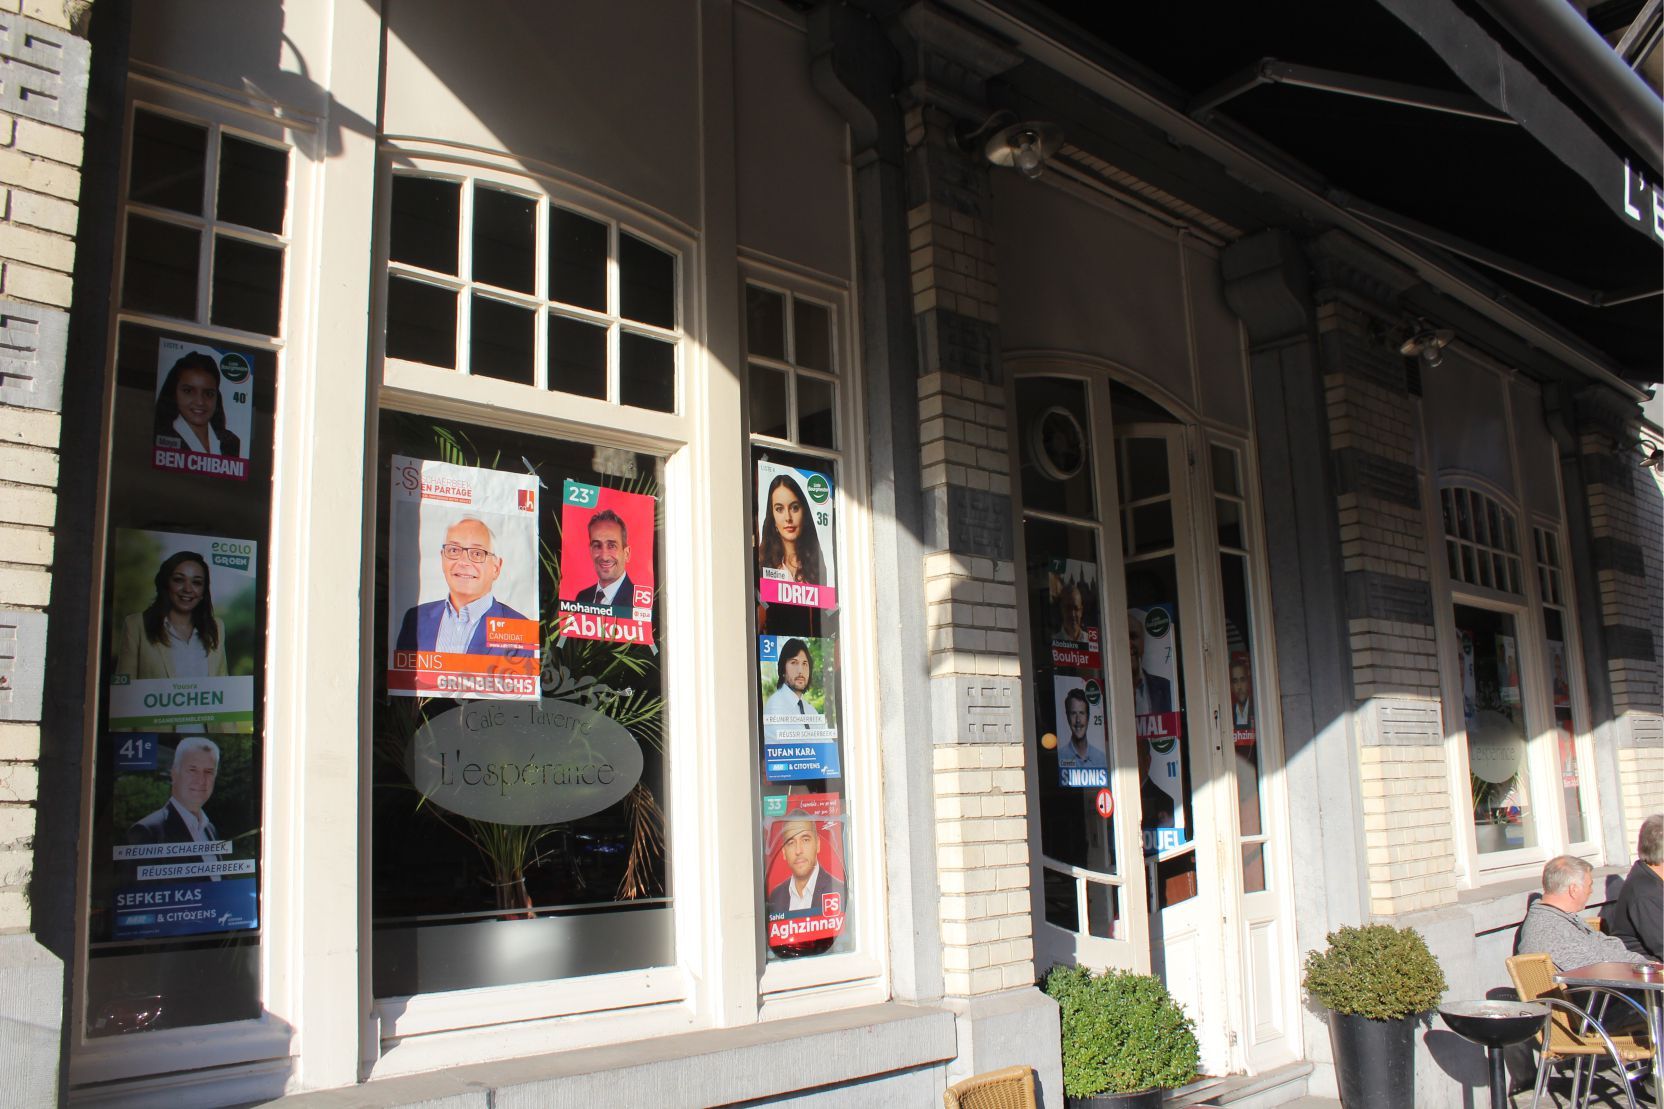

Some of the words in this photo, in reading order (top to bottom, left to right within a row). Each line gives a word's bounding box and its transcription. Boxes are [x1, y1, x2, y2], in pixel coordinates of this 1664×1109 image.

[156, 450, 185, 469] BEN
[187, 455, 244, 476] CHIBANI
[420, 483, 432, 492] EN
[434, 486, 472, 497] PARTAGE
[211, 542, 251, 555] ecolo
[214, 556, 248, 567] GROEN
[765, 568, 785, 580] Medine
[635, 590, 651, 604] PS
[778, 583, 819, 606] IDRIZI
[560, 601, 613, 616] Mohamed
[489, 620, 505, 631] 1er
[563, 614, 644, 641] Abkoui
[489, 633, 523, 641] CANDIDAT
[1088, 630, 1097, 640] PS
[397, 653, 442, 669] DENIS
[1051, 650, 1089, 665] Bouhjar
[114, 676, 128, 684] 20
[437, 675, 533, 693] GRIMBERGHS
[144, 691, 223, 708] OUCHEN
[465, 706, 504, 731] Café
[528, 704, 594, 736] Taverne
[767, 748, 793, 757] TUFAN
[795, 747, 816, 757] KARA
[440, 750, 616, 797] L'espérance
[1061, 769, 1107, 786] SIMONIS
[184, 862, 244, 875] SCHAERBEEK
[117, 891, 171, 906] SEFKET
[174, 889, 202, 902] KAS
[824, 897, 839, 912] PS
[156, 914, 164, 922] &
[166, 909, 217, 922] CITOYENS
[768, 913, 785, 921] Sahid
[770, 915, 844, 938] Aghzinnay
